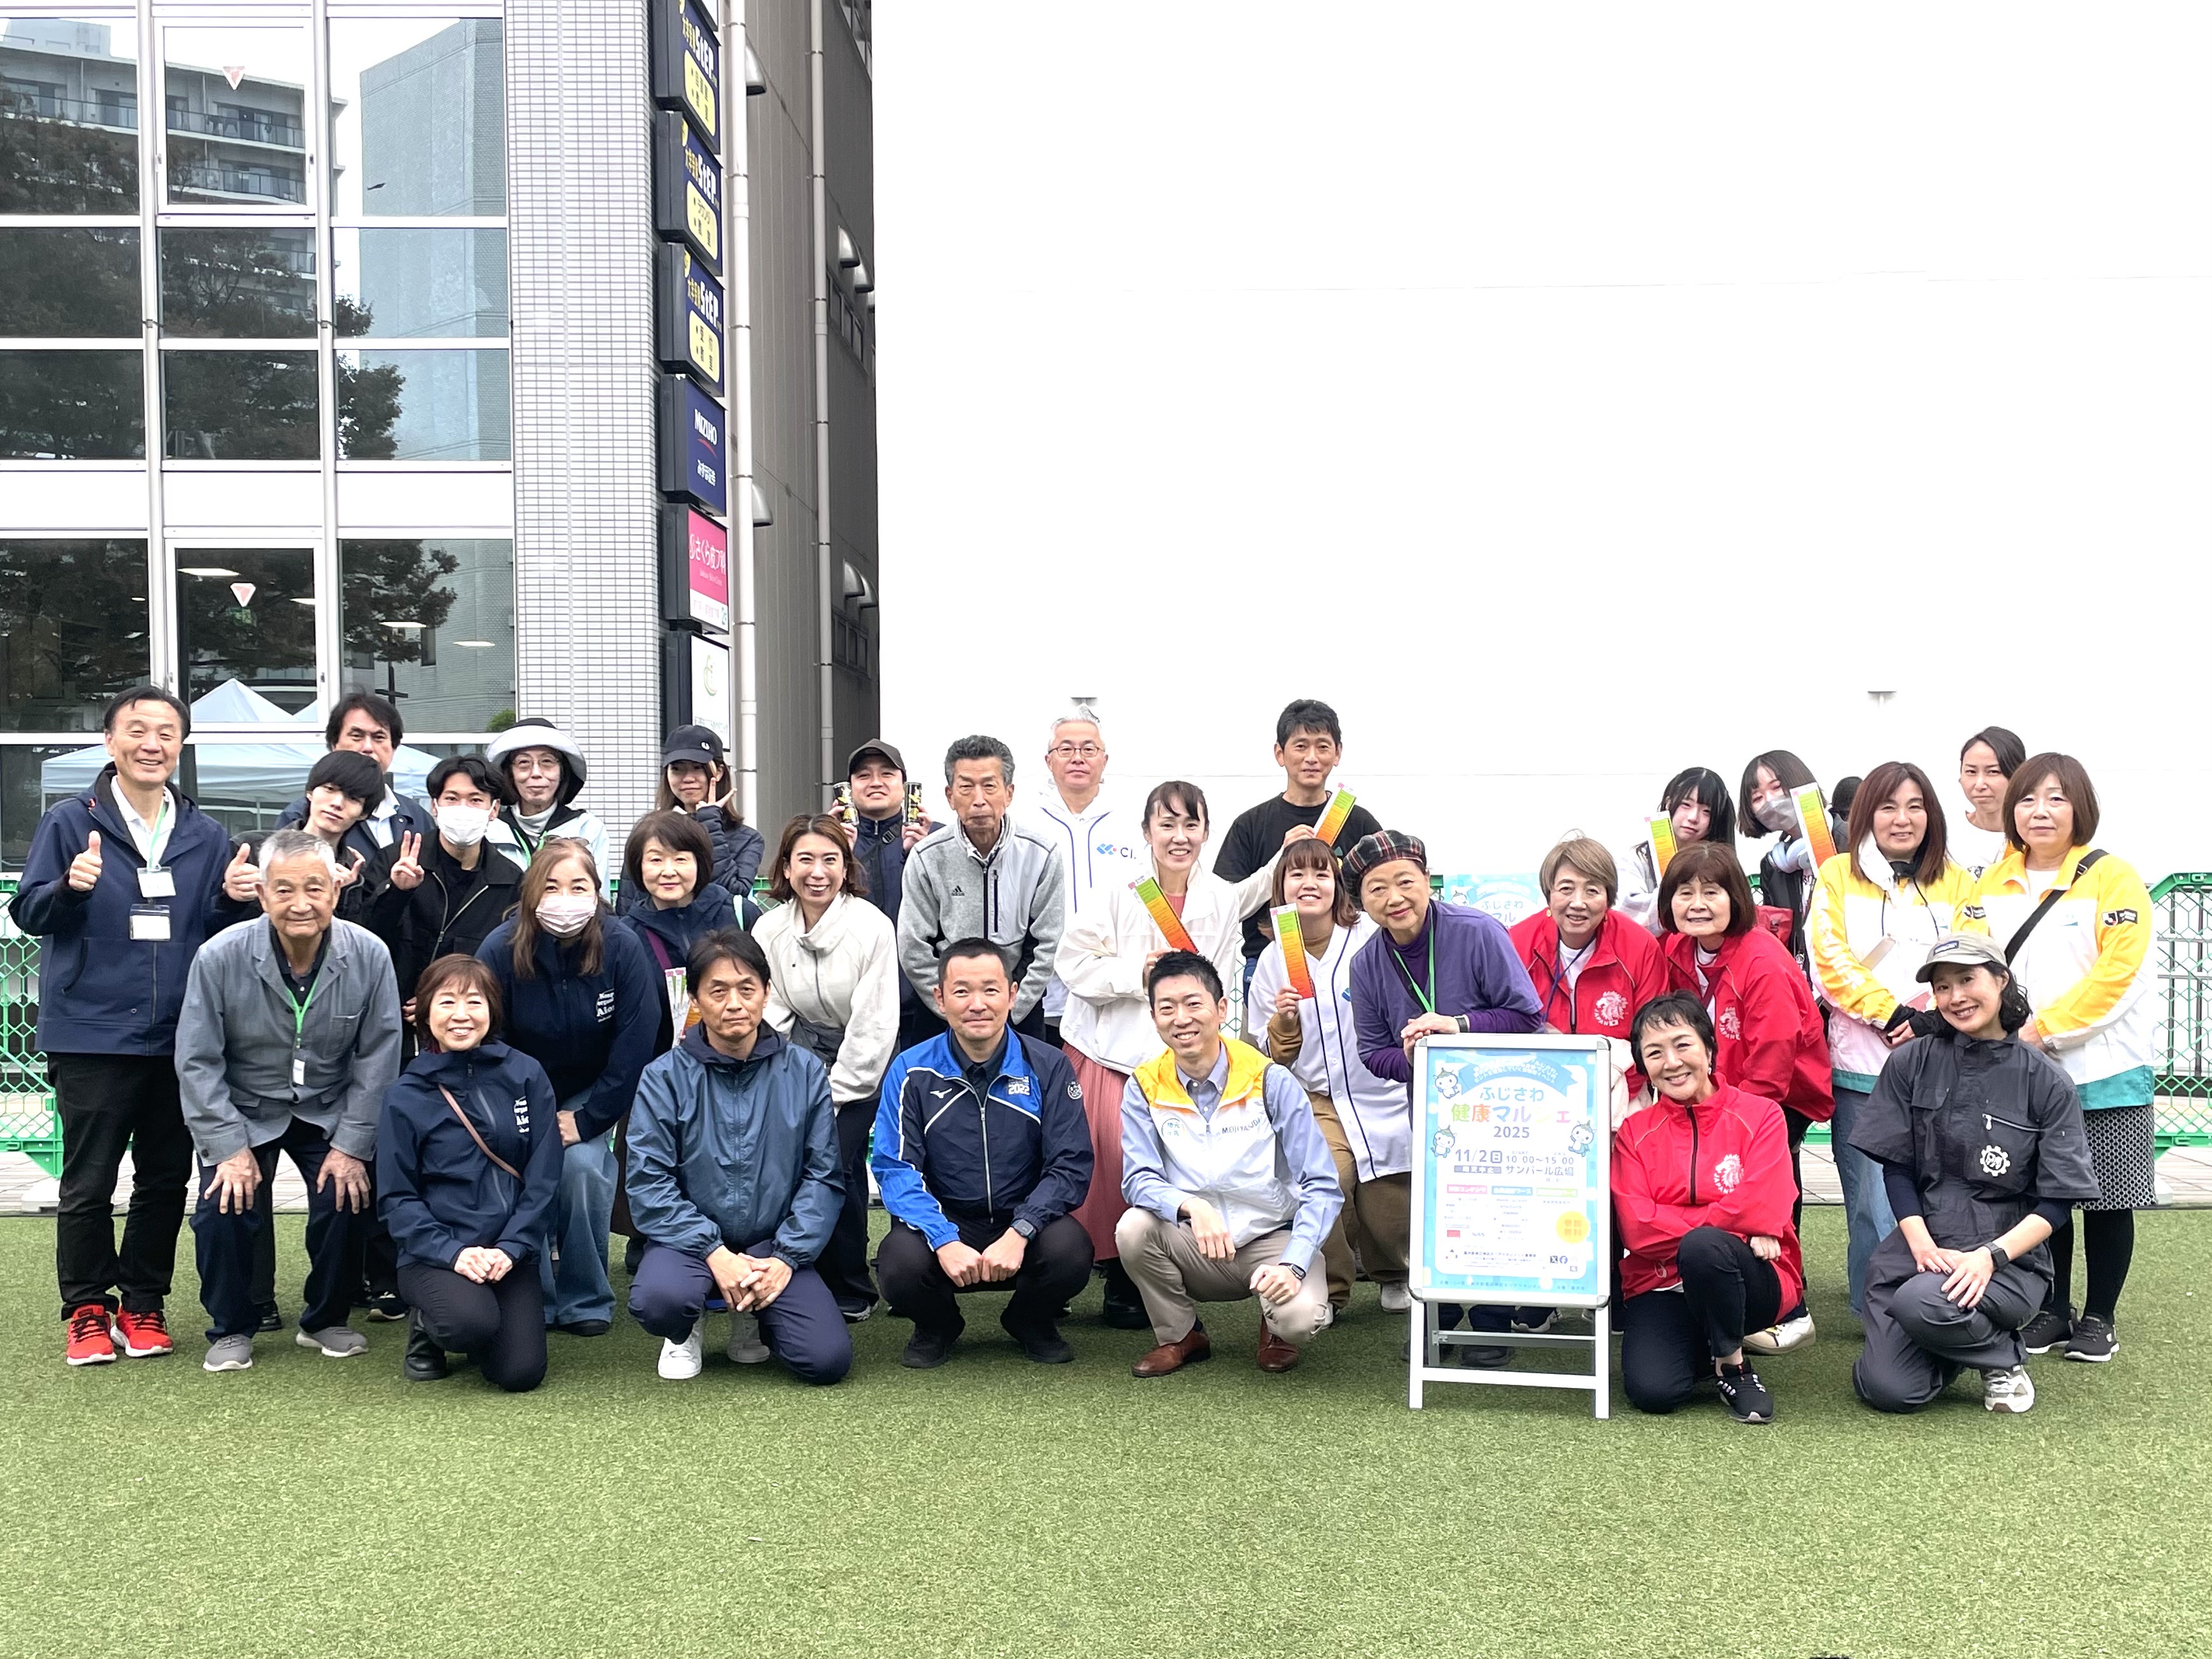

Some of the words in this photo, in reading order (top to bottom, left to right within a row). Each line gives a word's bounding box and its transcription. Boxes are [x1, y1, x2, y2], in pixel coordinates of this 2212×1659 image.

[694, 408, 717, 446] MIZUHO
[1008, 1083, 1030, 1095] 2022
[1479, 1087, 1545, 1102] ふじさわ
[1493, 1125, 1530, 1139] 2025
